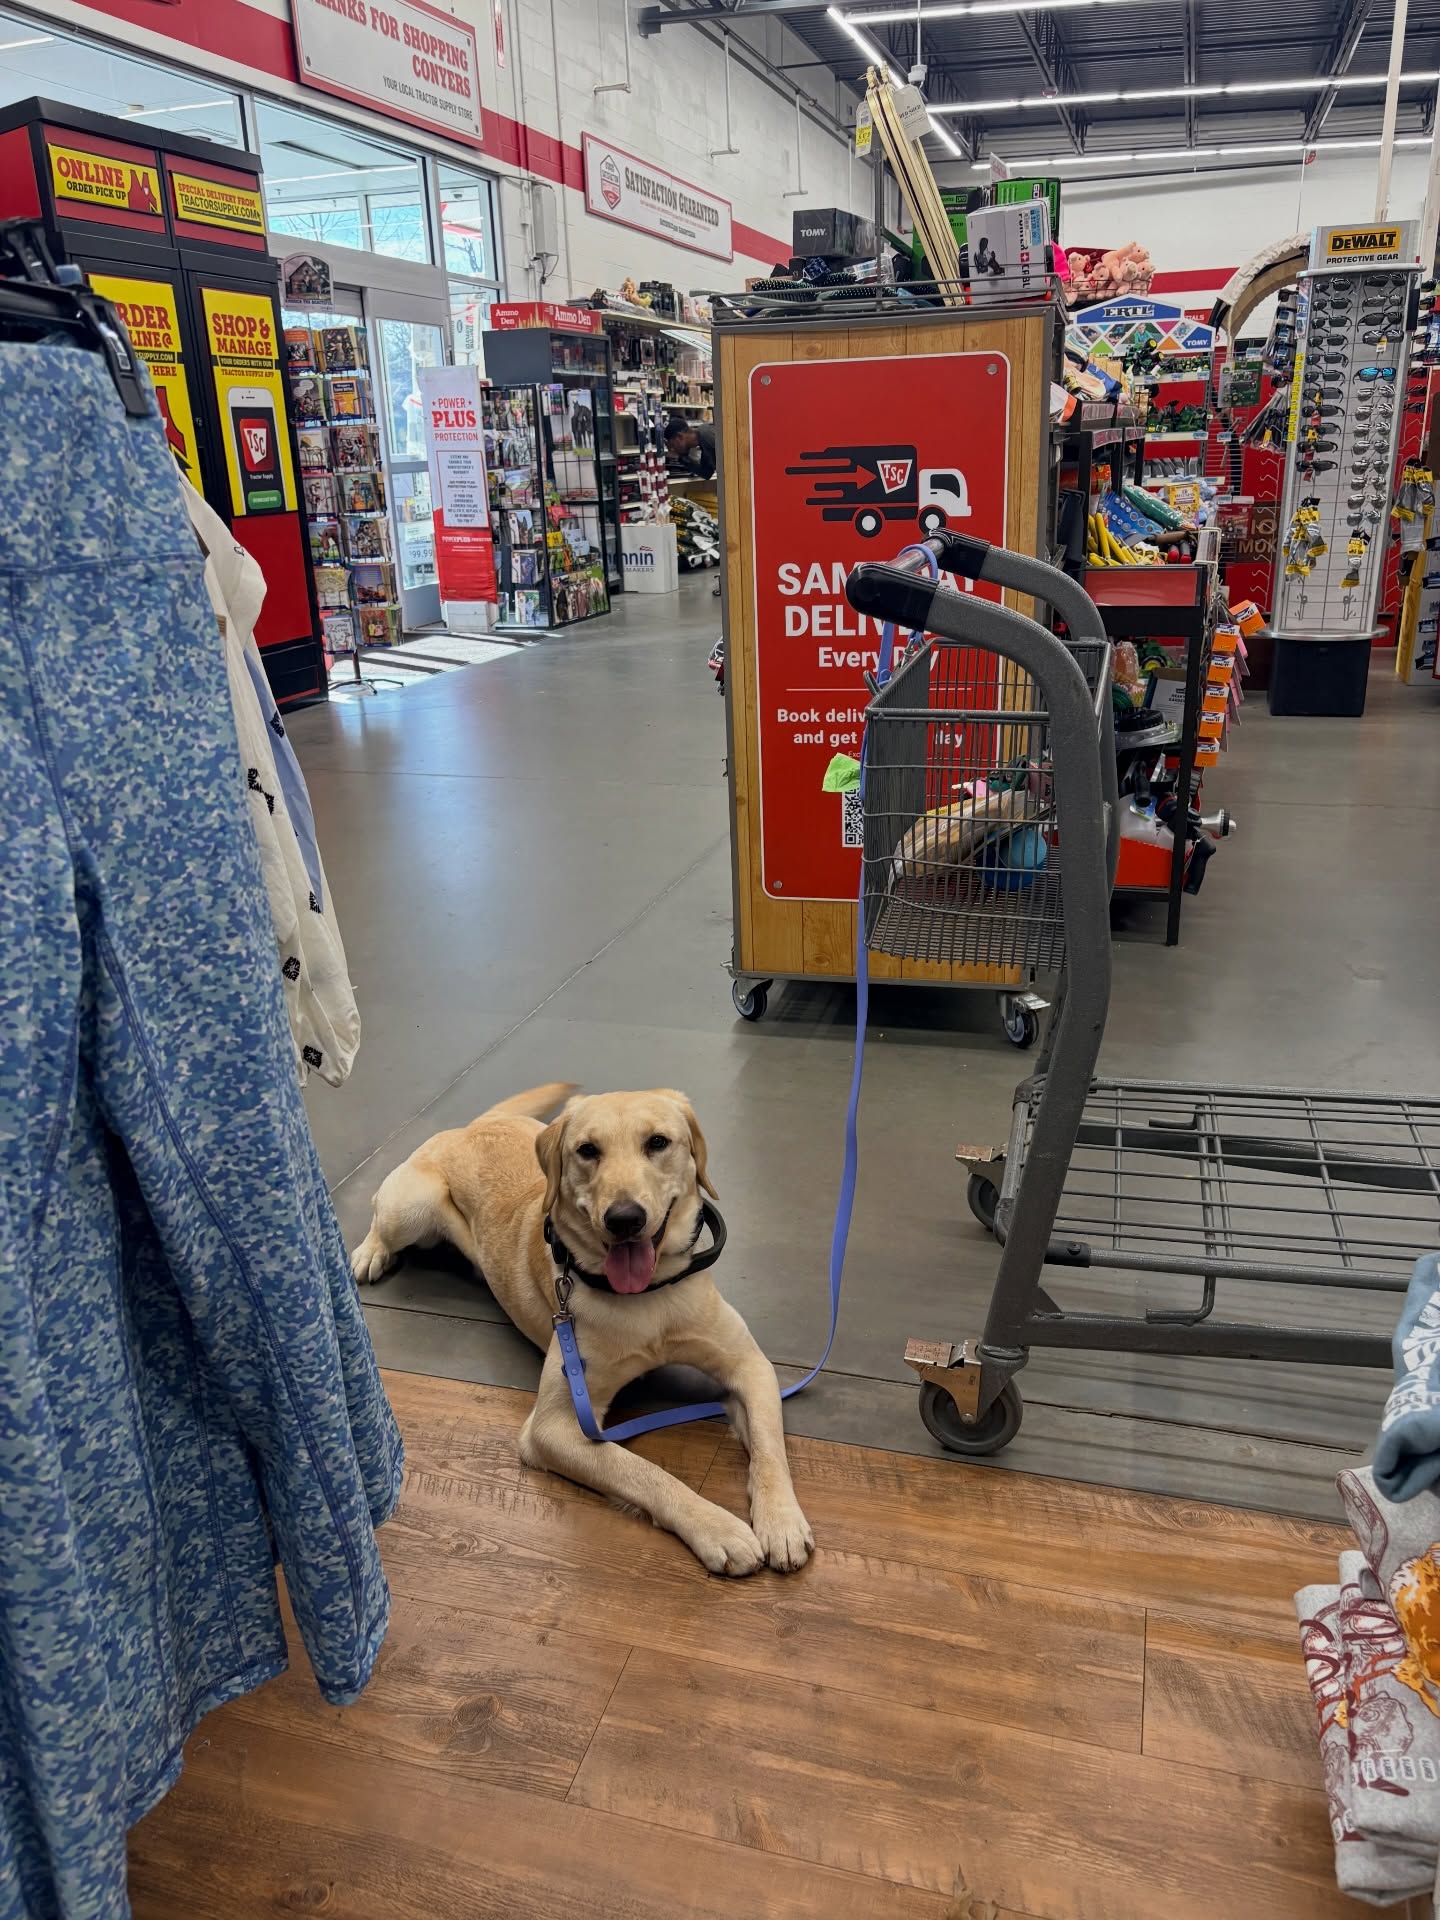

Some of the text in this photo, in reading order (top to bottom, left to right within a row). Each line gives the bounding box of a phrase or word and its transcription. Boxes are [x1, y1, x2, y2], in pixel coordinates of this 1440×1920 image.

[369, 6, 400, 42] FOR
[402, 22, 469, 72] SHOPPING
[412, 54, 471, 98] CONYERS
[382, 75, 473, 121] YOUR LOCAL TRACTOR SUPPLY STORE
[56, 156, 125, 189] ONLINE
[66, 180, 126, 201] ORDER PICK UP
[177, 182, 257, 209] SPECIAL DELIVERY FROM
[624, 166, 678, 212] SATISFACTION
[679, 192, 720, 227] GUARANTEED
[178, 192, 258, 220] TRACTORSUPPLY.COM
[800, 228, 827, 238] TOMY
[1326, 253, 1399, 264] PROTECTIVE GEAR
[114, 302, 172, 330] RDER
[495, 309, 519, 317] Ammo
[555, 306, 592, 326] Ammo Den
[1102, 304, 1155, 318] ERTL
[212, 312, 271, 340] SHOP &
[500, 317, 515, 325] Den
[127, 330, 174, 349] LINE@
[216, 337, 273, 357] MANAGE
[134, 351, 174, 362] RSUPPLY.COM
[220, 357, 233, 365] YOUR
[233, 358, 250, 366] ORDERS
[250, 359, 263, 367] WITH
[152, 365, 178, 377] HERE
[221, 368, 245, 377] TRACTOR
[245, 369, 264, 378] SUPPLY
[438, 397, 466, 409] POWER
[431, 410, 477, 428] PLUS
[246, 429, 266, 457] TSC
[434, 432, 479, 441] PROTECTION
[883, 463, 905, 485] TSC
[777, 708, 867, 723] Book deliv
[793, 730, 824, 744] and
[829, 731, 858, 748] get
